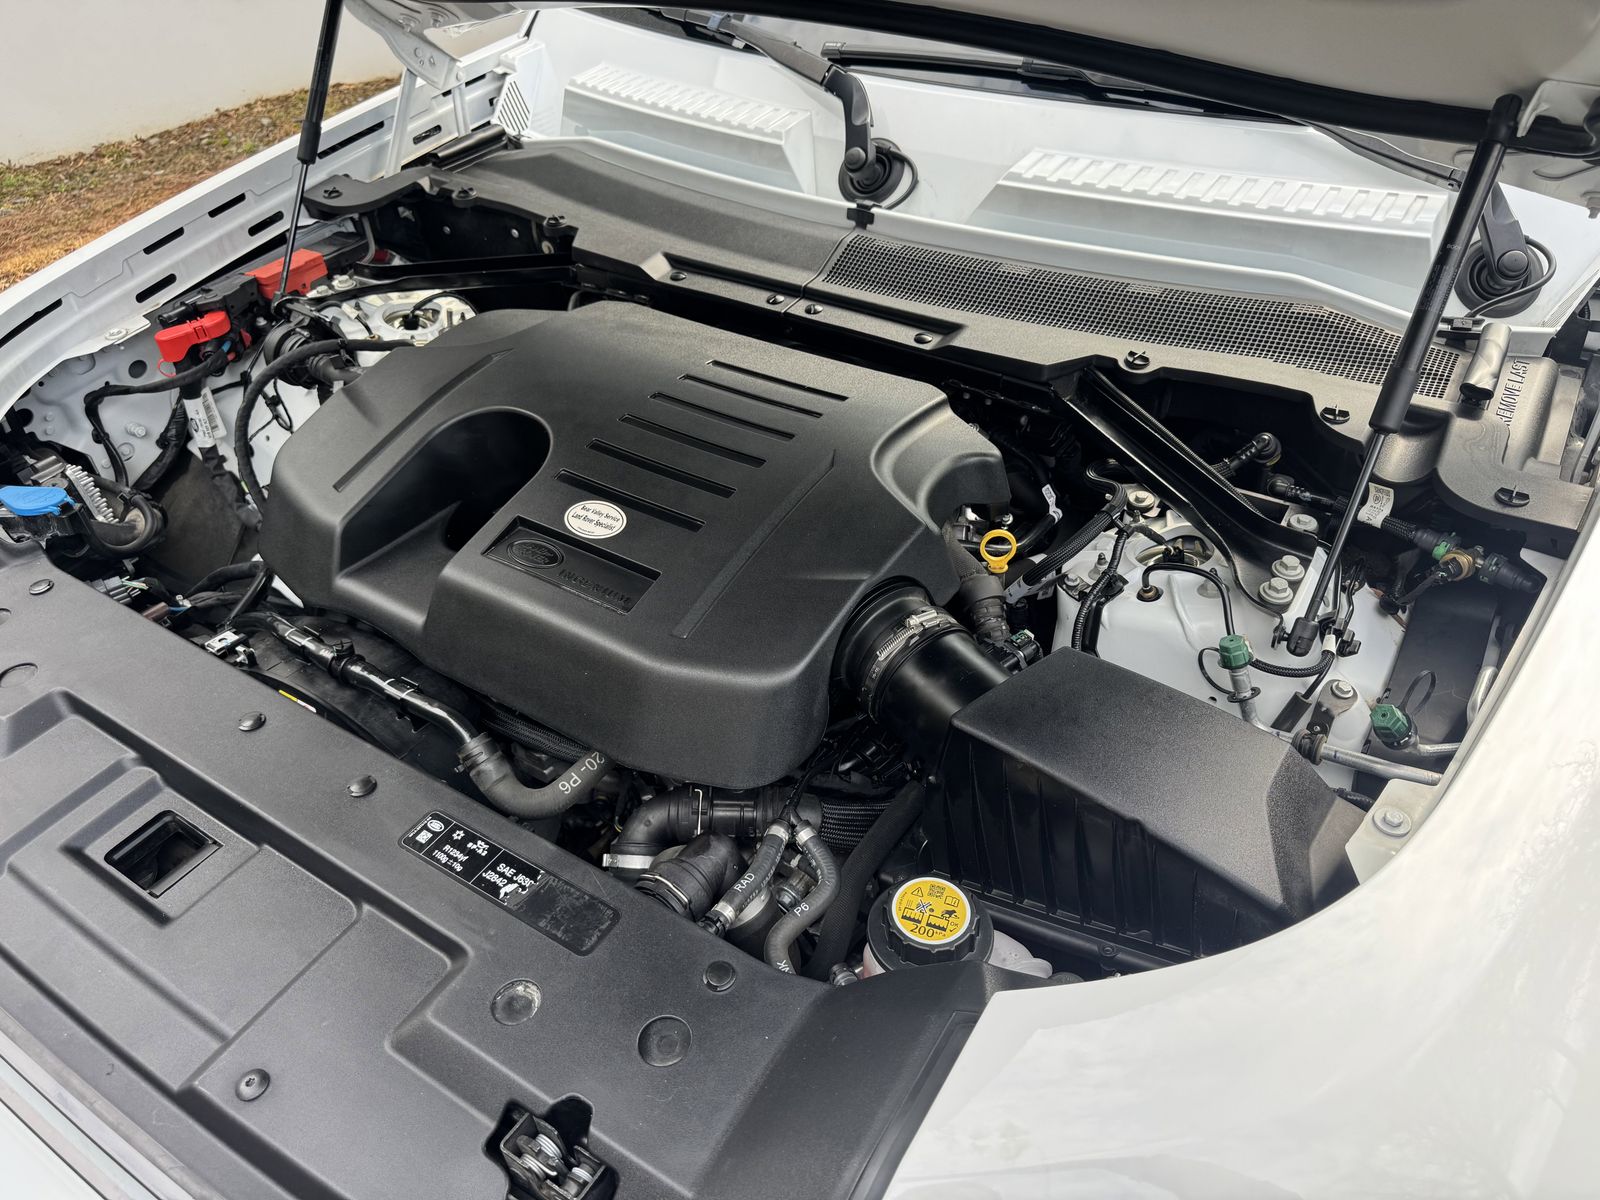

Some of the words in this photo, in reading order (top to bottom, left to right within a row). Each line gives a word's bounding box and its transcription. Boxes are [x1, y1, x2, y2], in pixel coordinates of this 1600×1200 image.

[1508, 359, 1531, 385] LAST
[571, 511, 582, 520] Land
[582, 516, 596, 524] Rover
[591, 508, 605, 518] Valley
[604, 512, 620, 523] Service
[558, 772, 582, 795] P6
[482, 870, 508, 887] J2842
[496, 863, 517, 878] SAE
[733, 872, 755, 893] RAD
[793, 901, 810, 917] P6
[910, 923, 935, 938] 200
